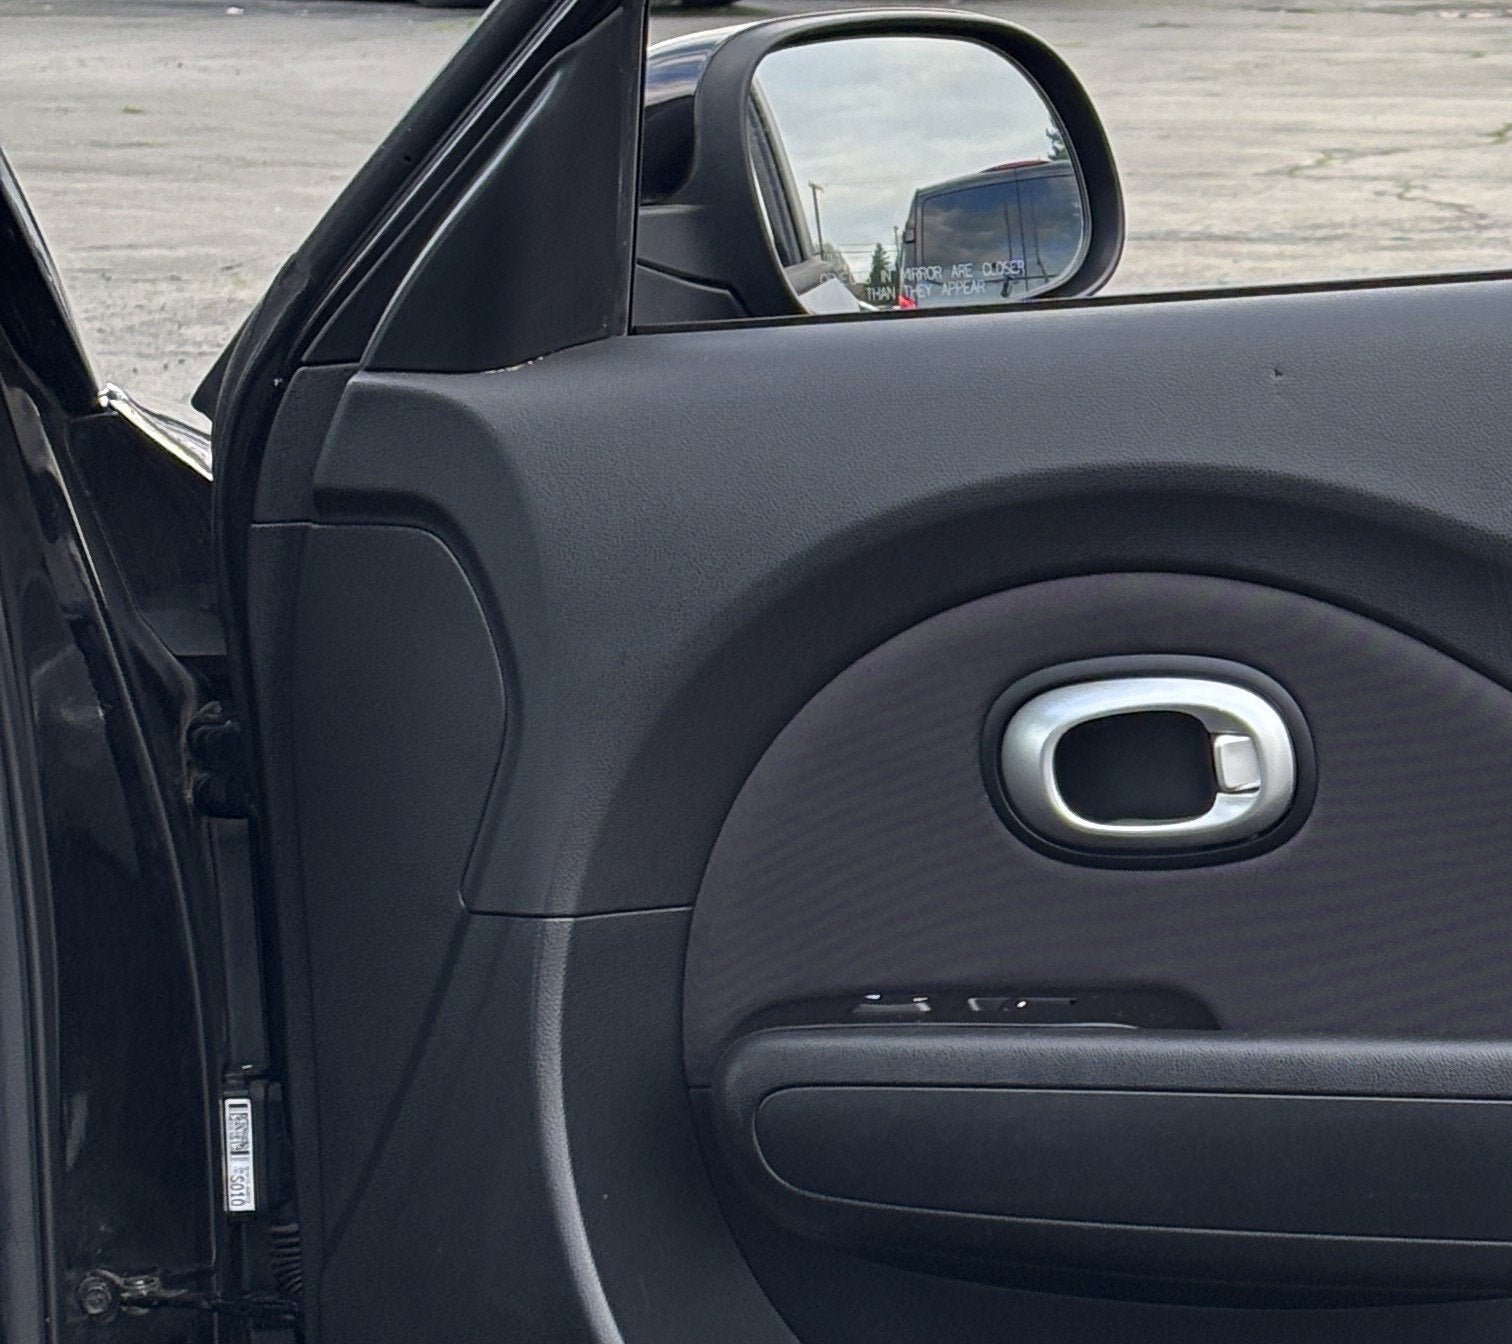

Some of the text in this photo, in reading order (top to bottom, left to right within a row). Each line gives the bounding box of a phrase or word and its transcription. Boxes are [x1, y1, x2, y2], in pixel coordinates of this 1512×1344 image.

[880, 269, 893, 284] IN
[902, 265, 944, 283] MIRROR
[951, 262, 974, 279] ARE
[981, 259, 1026, 277] CLOSER
[867, 278, 986, 302] THAN THEY APPEAR
